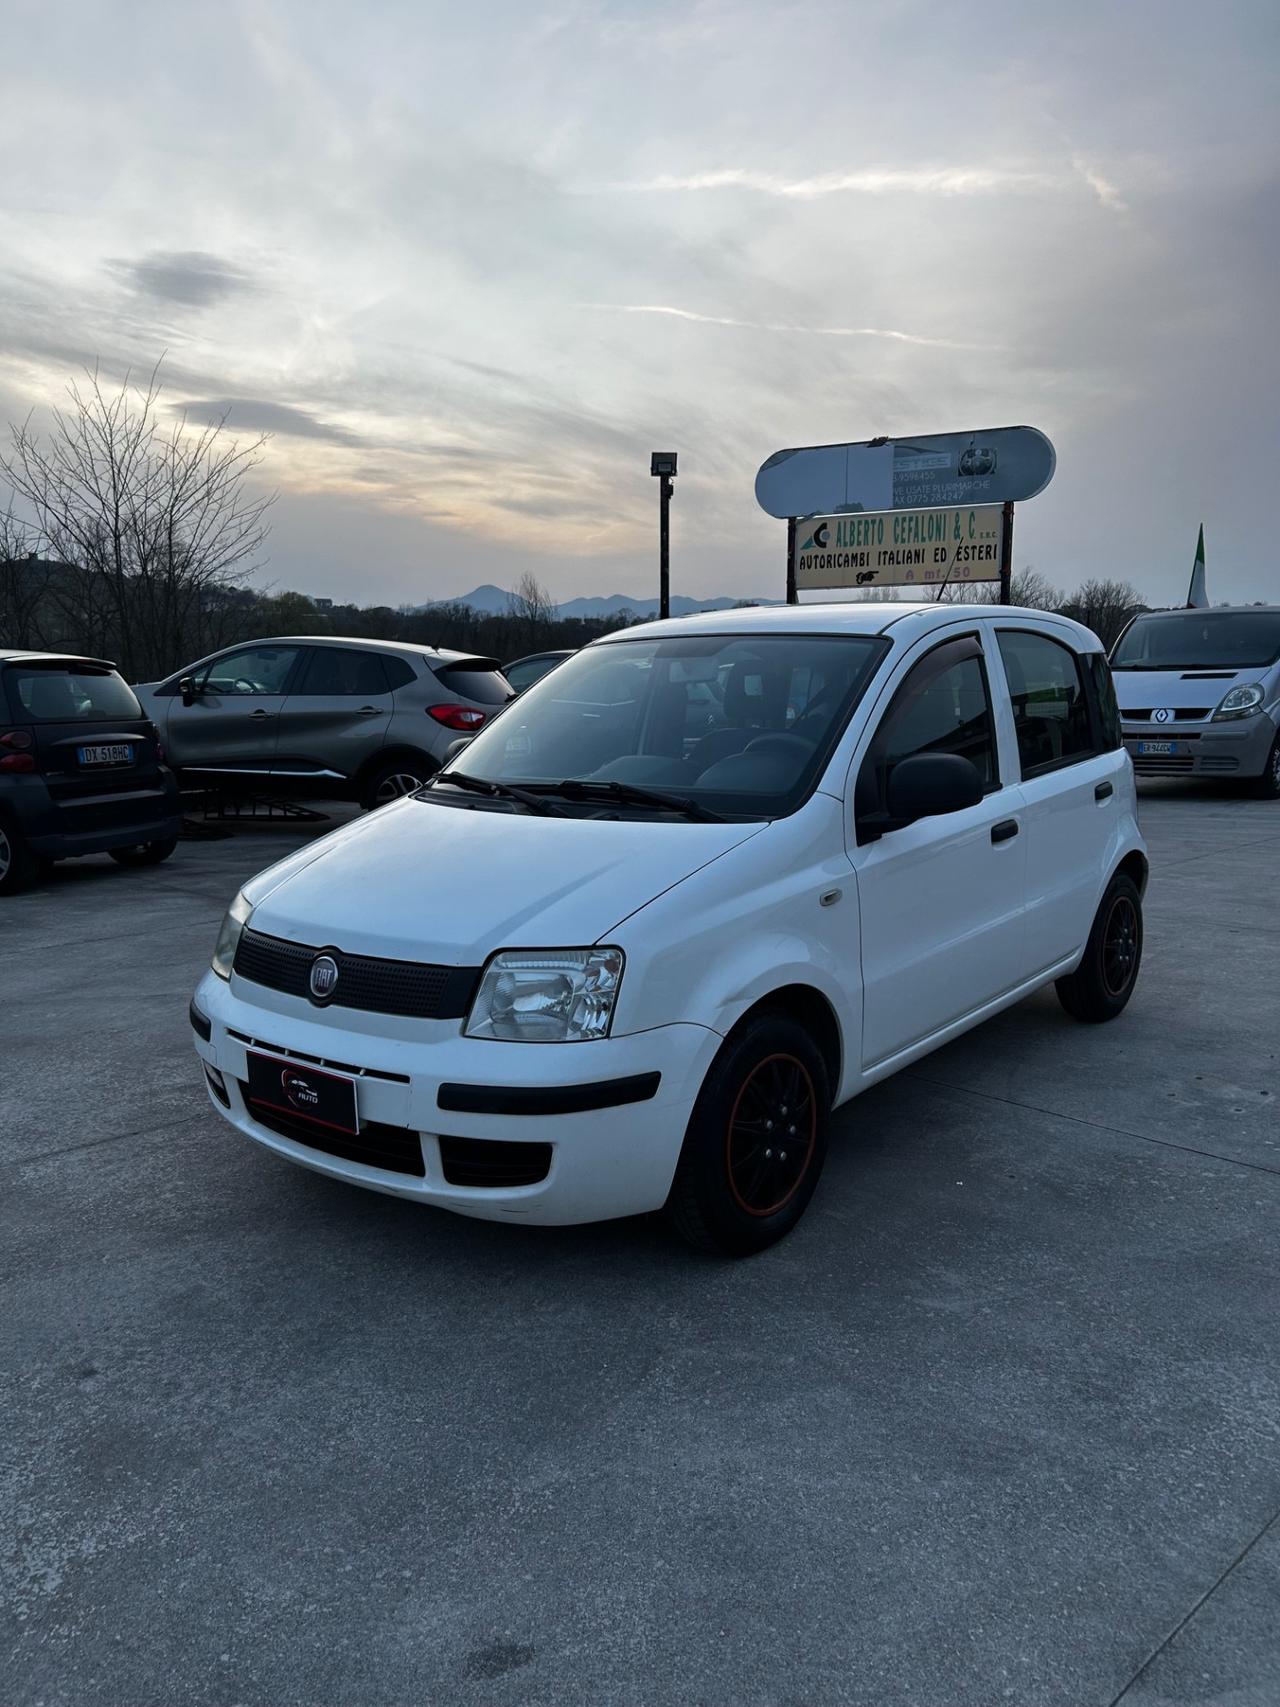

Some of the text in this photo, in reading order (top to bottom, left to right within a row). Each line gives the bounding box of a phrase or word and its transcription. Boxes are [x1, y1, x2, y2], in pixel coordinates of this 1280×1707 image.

[906, 484, 930, 495] USATE
[932, 480, 990, 493] PLURIMARCHE
[907, 493, 928, 504] 0775
[836, 518, 884, 548] ALBERTO
[893, 513, 946, 545] CEFALONI
[953, 511, 961, 541] &
[800, 543, 997, 570] AUTORICAMBI ITALIANI ED ESTERI
[905, 569, 914, 581] A
[953, 566, 970, 578] 50
[85, 746, 128, 761] DX 518HC
[298, 1092, 318, 1104] AUTO
